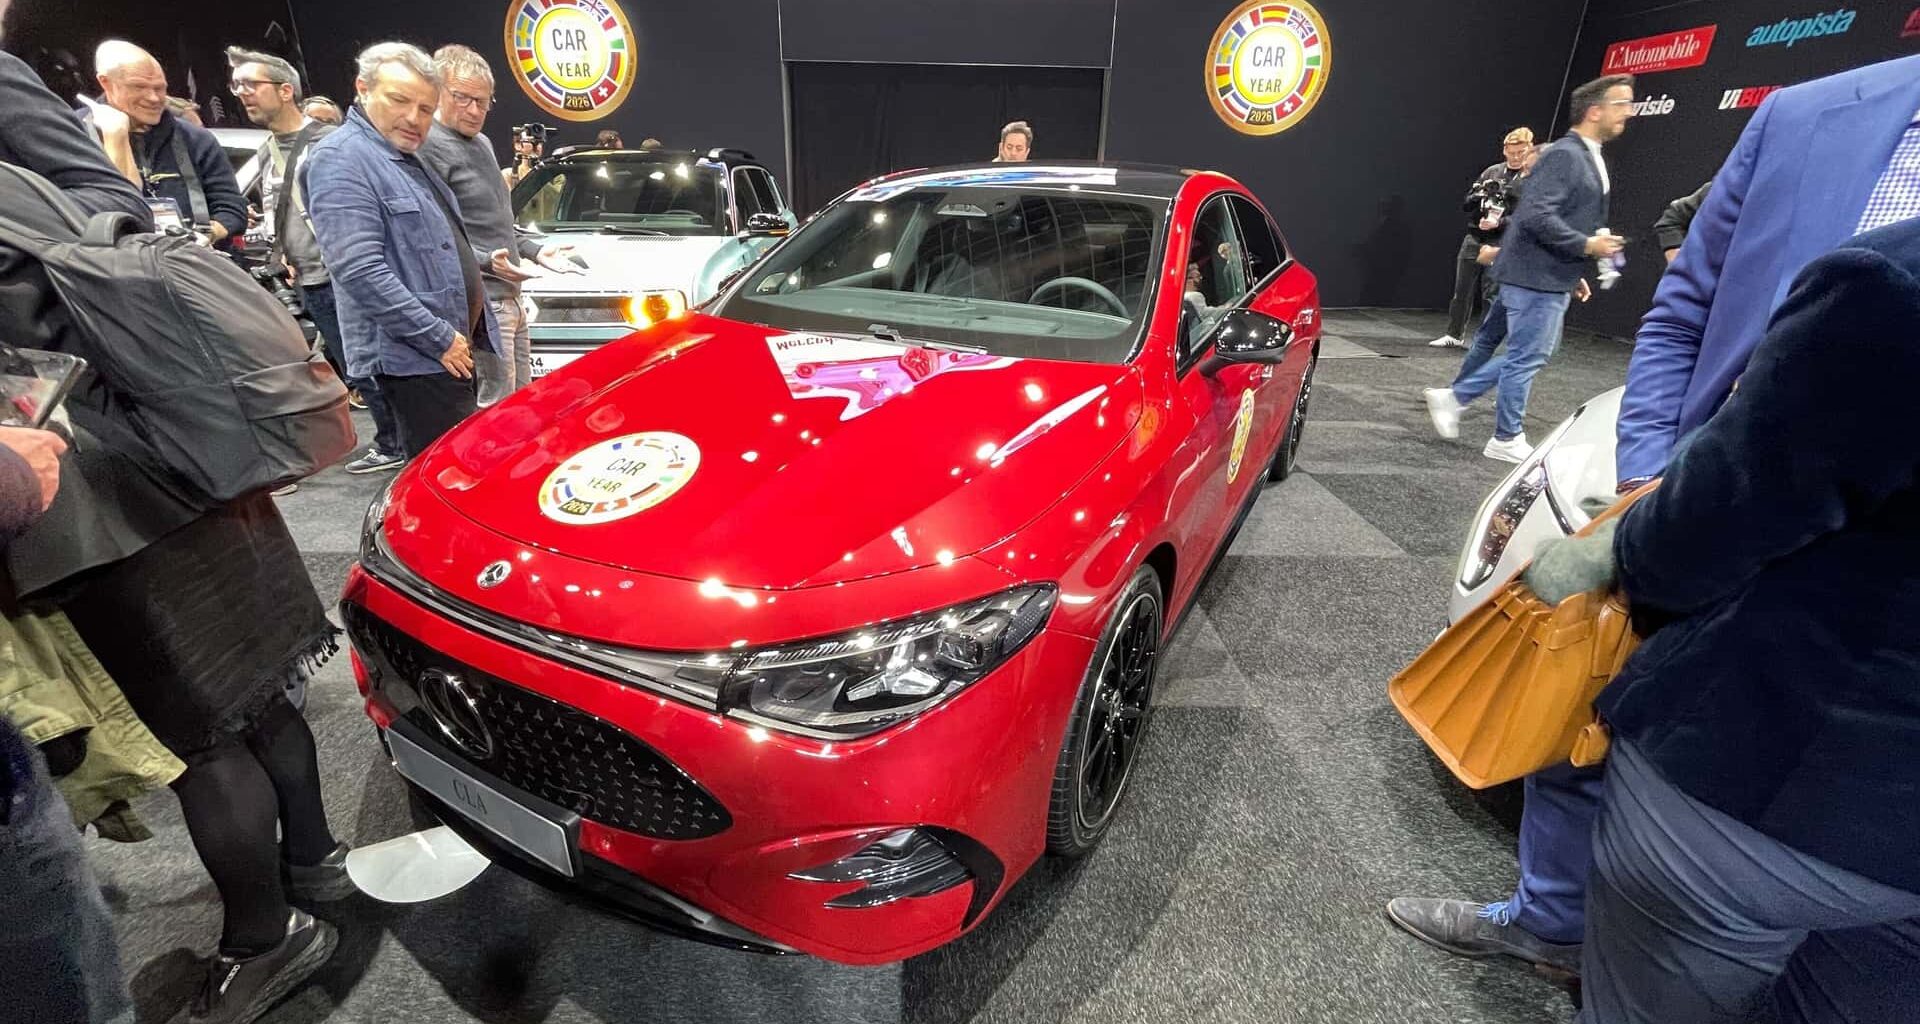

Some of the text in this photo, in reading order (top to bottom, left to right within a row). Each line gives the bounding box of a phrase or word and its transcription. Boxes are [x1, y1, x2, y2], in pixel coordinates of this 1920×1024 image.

[1746, 9, 1857, 48] autopista
[552, 28, 588, 51] CAR
[1252, 46, 1286, 67] CAR
[1608, 33, 1700, 69] L'Automobile
[556, 62, 592, 78] YEAR
[1250, 78, 1282, 93] YEAR
[565, 95, 590, 109] 2026
[1631, 94, 1675, 116] visie
[1250, 110, 1273, 122] 2026
[606, 458, 647, 476] CAR
[587, 477, 623, 493] YEAR
[562, 500, 590, 514] 2026
[453, 779, 488, 815] CLA
